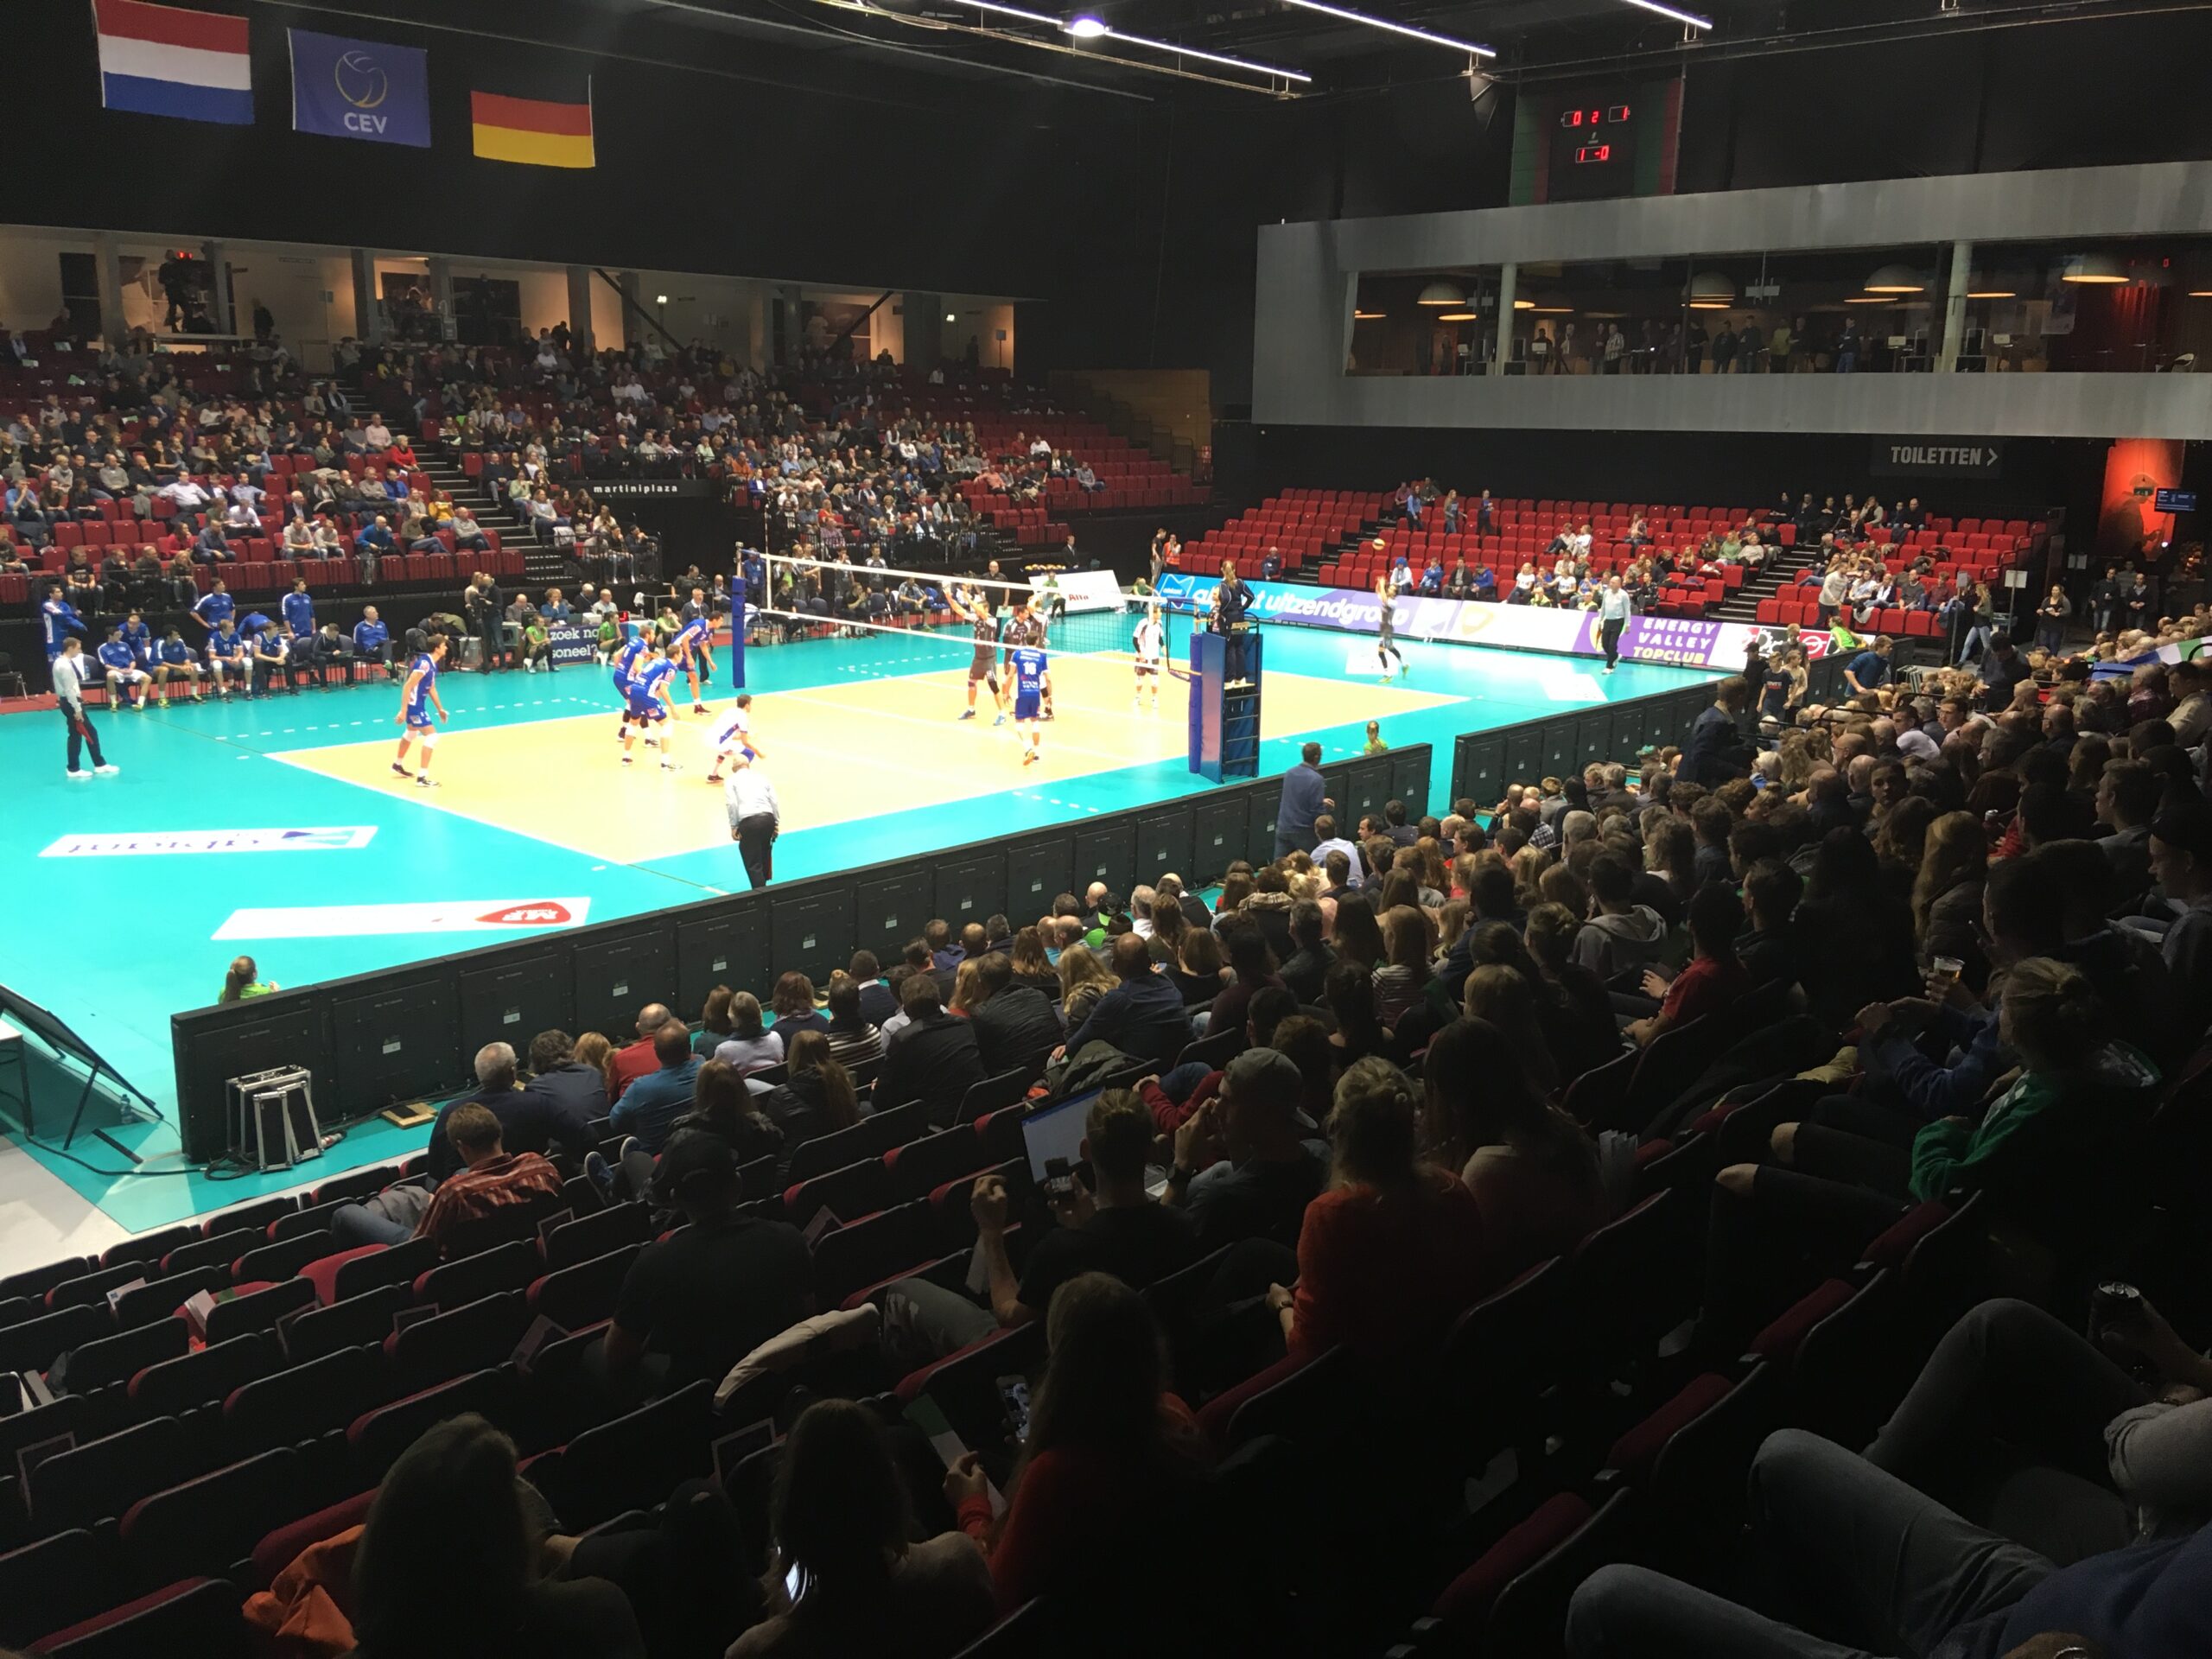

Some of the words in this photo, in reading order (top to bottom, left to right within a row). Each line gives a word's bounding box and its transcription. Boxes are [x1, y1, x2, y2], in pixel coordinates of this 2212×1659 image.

[343, 111, 388, 134] CEV
[1573, 110, 1582, 126] 0
[1591, 111, 1599, 124] 2
[1891, 446, 1982, 466] TOILETTEN
[593, 484, 678, 494] martiniplaza
[1264, 592, 1410, 626] uitzendgrop
[550, 627, 581, 641] zoek
[1643, 617, 1717, 635] ENERGY
[1638, 632, 1712, 650] VALLEY
[1633, 645, 1706, 664] TOPCLUB
